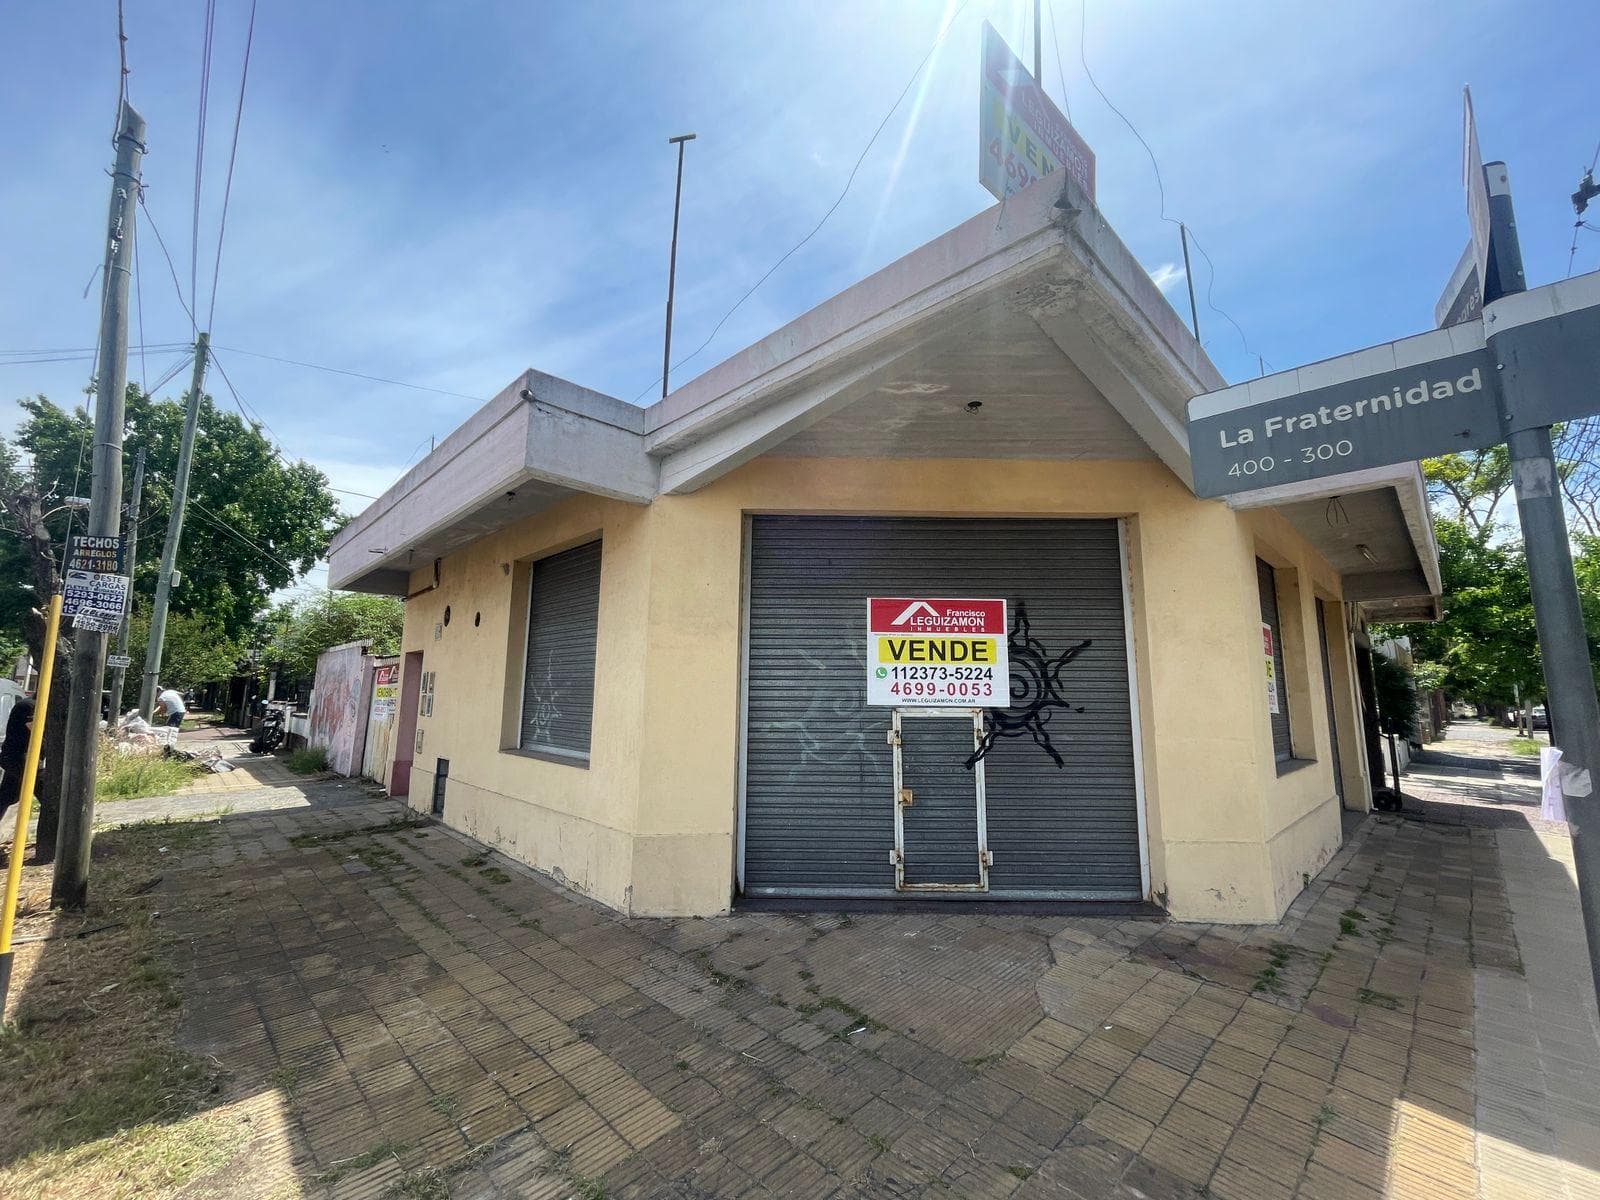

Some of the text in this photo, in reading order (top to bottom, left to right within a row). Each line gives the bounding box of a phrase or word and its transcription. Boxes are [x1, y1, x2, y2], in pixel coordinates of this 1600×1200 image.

[1219, 368, 1483, 448] La Fraternidad
[1228, 456, 1275, 478] 400
[1301, 440, 1353, 464] 300
[73, 536, 119, 549] TECHOS
[72, 549, 117, 558] ARREGLOS
[89, 580, 126, 590] CARGAS
[946, 609, 986, 617] Francisco
[910, 616, 985, 627] LEGUIZAMON
[887, 639, 989, 662] VENDE
[891, 666, 994, 681] 112373-5224
[890, 682, 993, 697] 4699-0053
